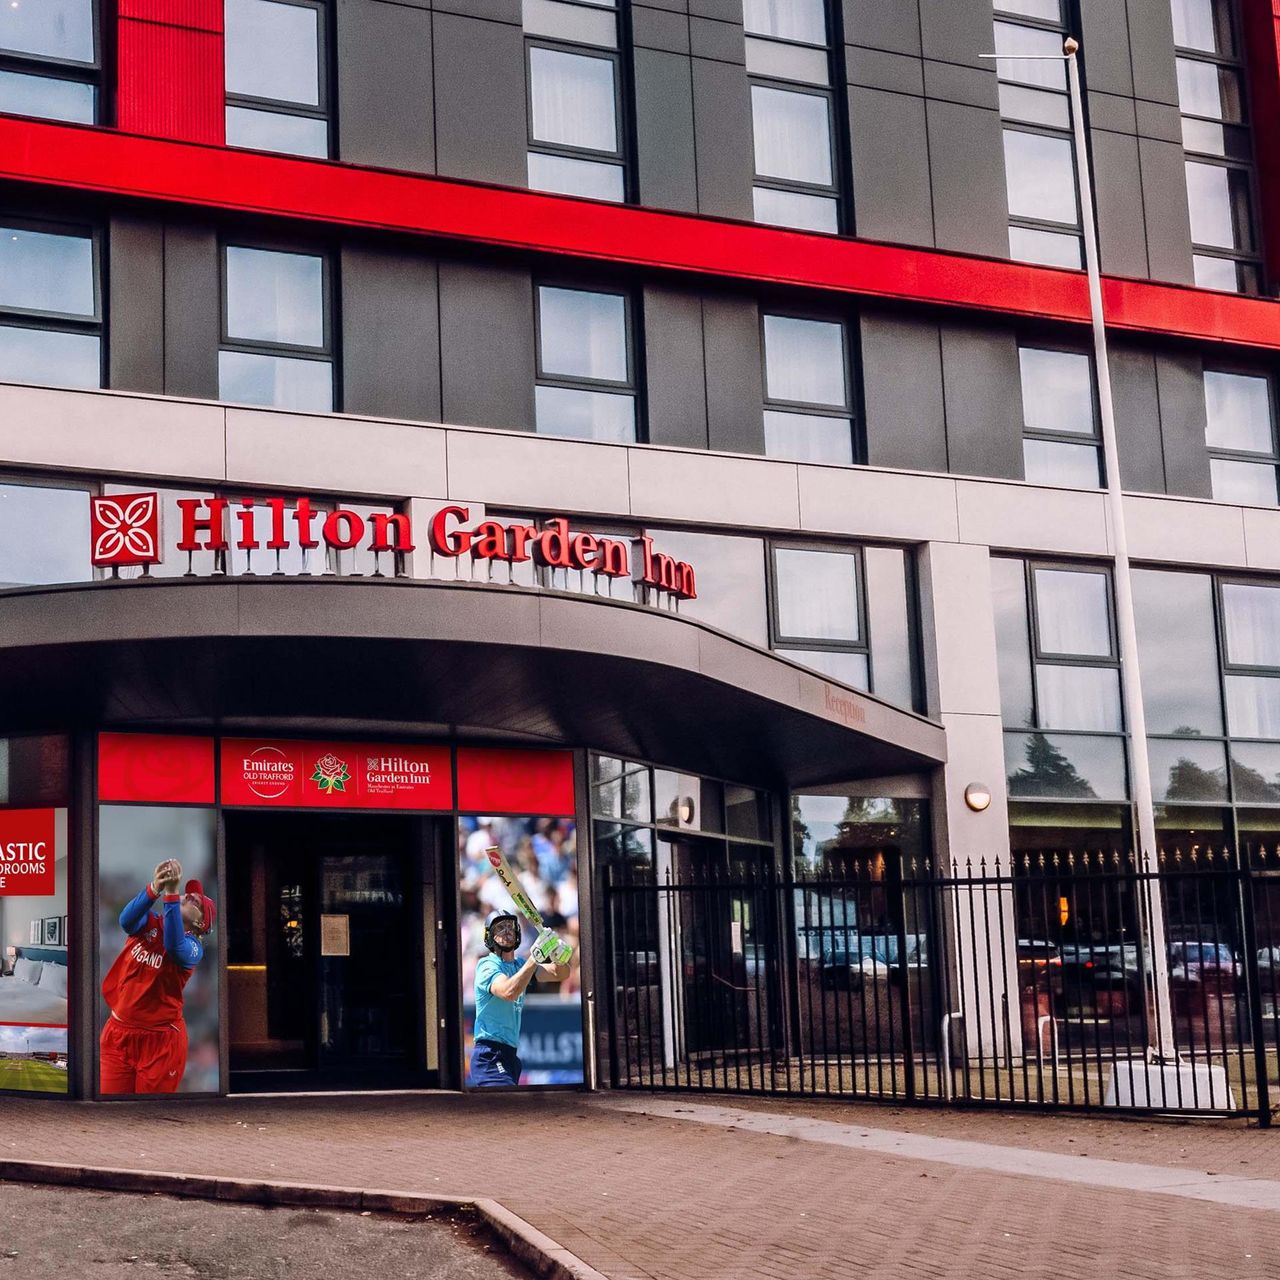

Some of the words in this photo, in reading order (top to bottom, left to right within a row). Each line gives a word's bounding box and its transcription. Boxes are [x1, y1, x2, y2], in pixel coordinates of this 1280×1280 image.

[176, 496, 416, 554] Hilton
[428, 506, 631, 578] Garden
[634, 535, 697, 600] Inn
[243, 759, 294, 772] Emirates
[380, 757, 429, 773] Hilton
[243, 772, 258, 780] OLD
[259, 773, 294, 781] TRAFFORD
[366, 771, 408, 783] Garden
[410, 773, 430, 784] Inn
